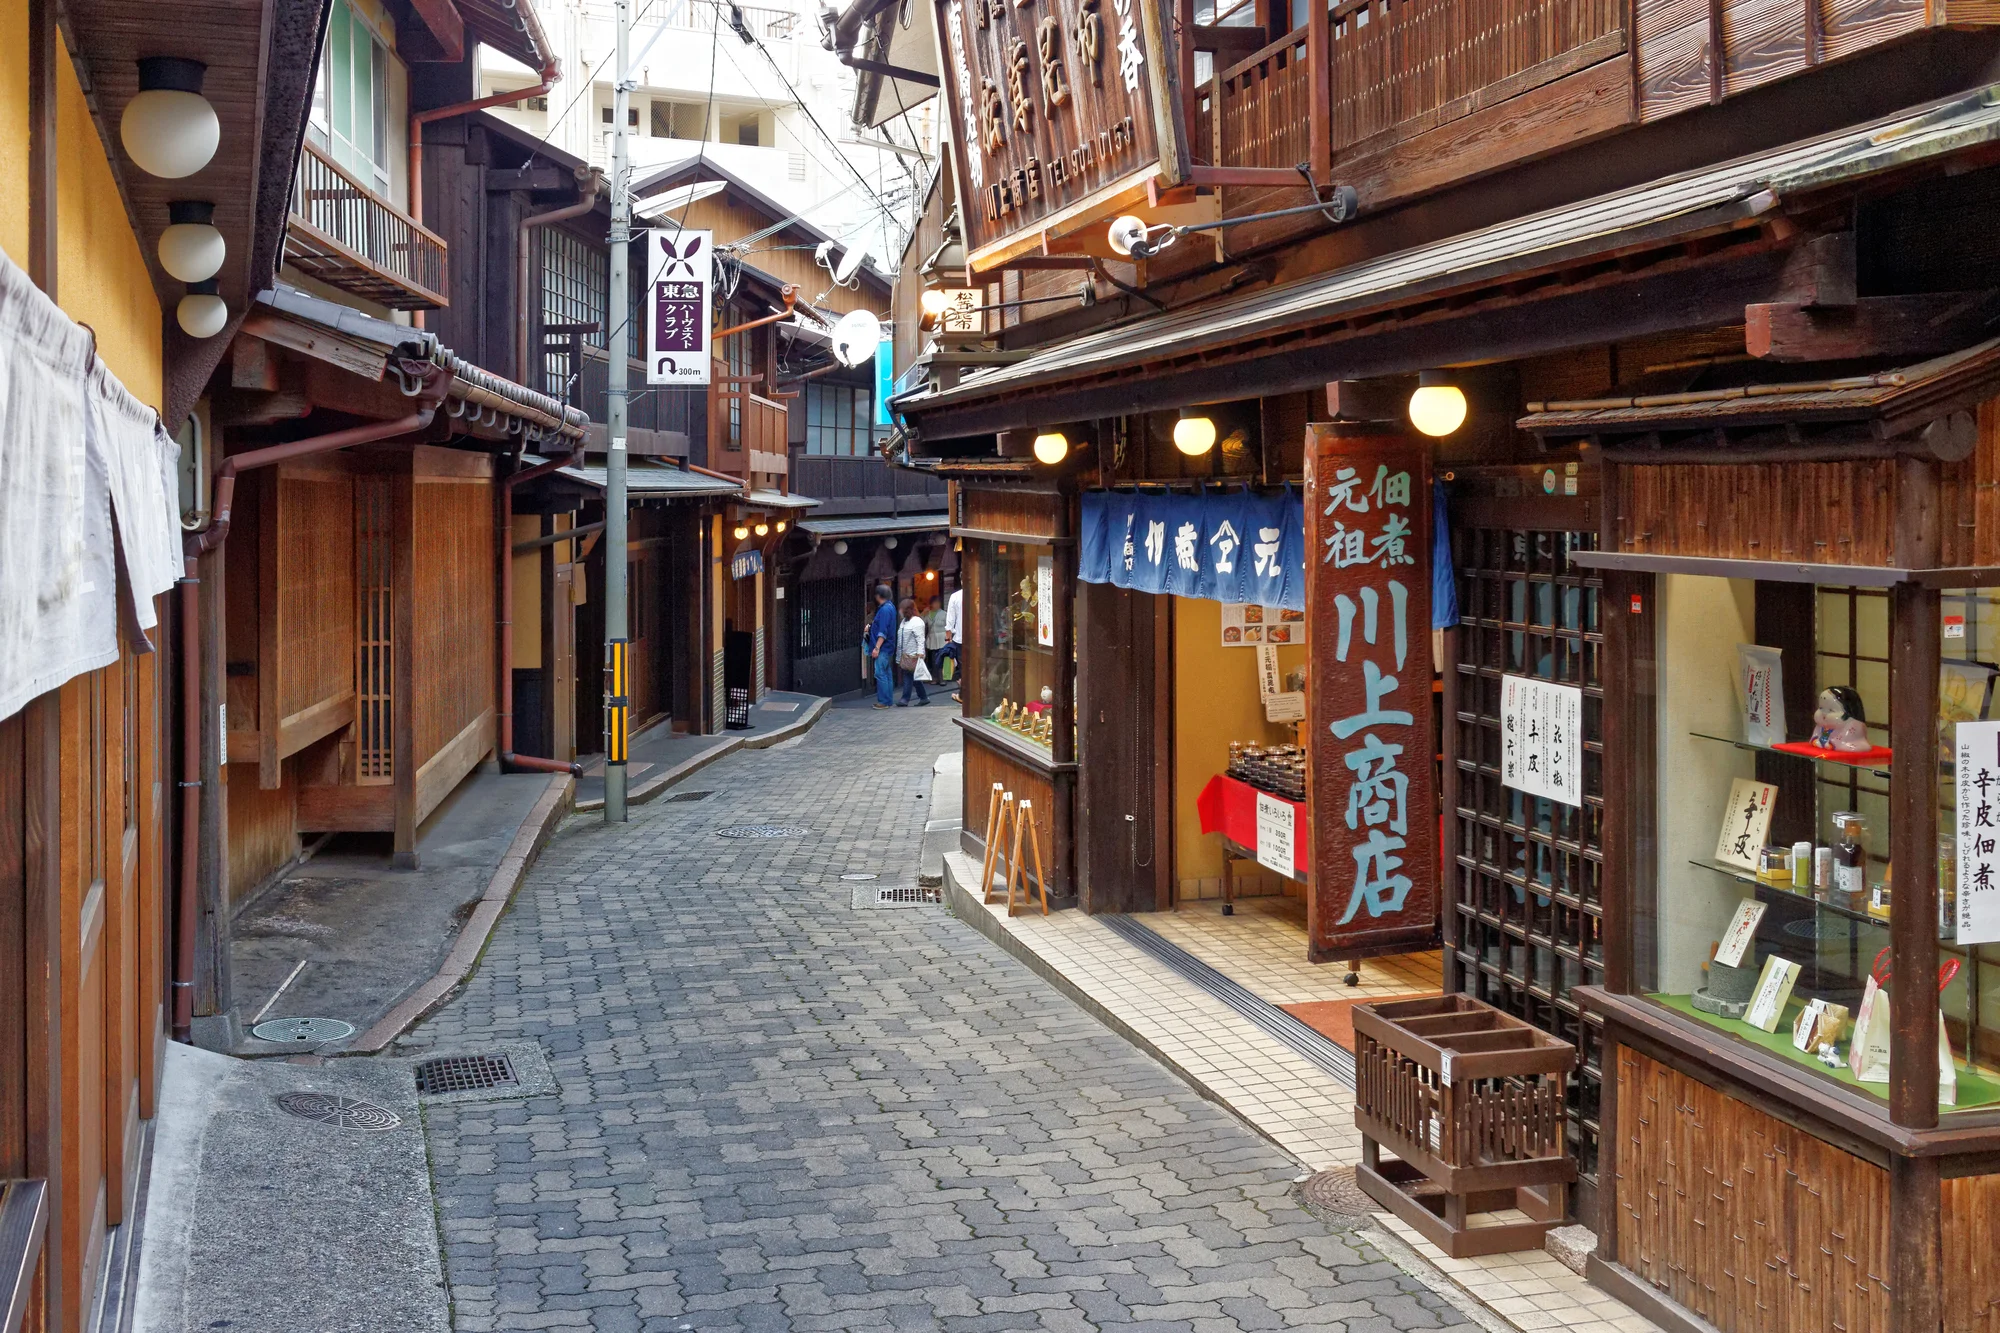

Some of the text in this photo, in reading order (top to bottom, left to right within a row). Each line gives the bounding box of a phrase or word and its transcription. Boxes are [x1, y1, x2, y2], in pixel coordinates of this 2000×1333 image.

[1113, 0, 1145, 95] 香
[984, 116, 1132, 223] 川上商店 TEL 904 0153
[661, 283, 700, 299] 東急
[664, 304, 679, 340] クラブ
[679, 304, 695, 349] ハーヴェスト
[678, 367, 701, 376] 300m
[1145, 519, 1199, 572] 佃煮
[1323, 467, 1370, 569] 元祖
[1369, 464, 1415, 569] 佃煮
[1329, 580, 1414, 926] 川上商店
[1972, 768, 1996, 892] 辛皮佃煮
